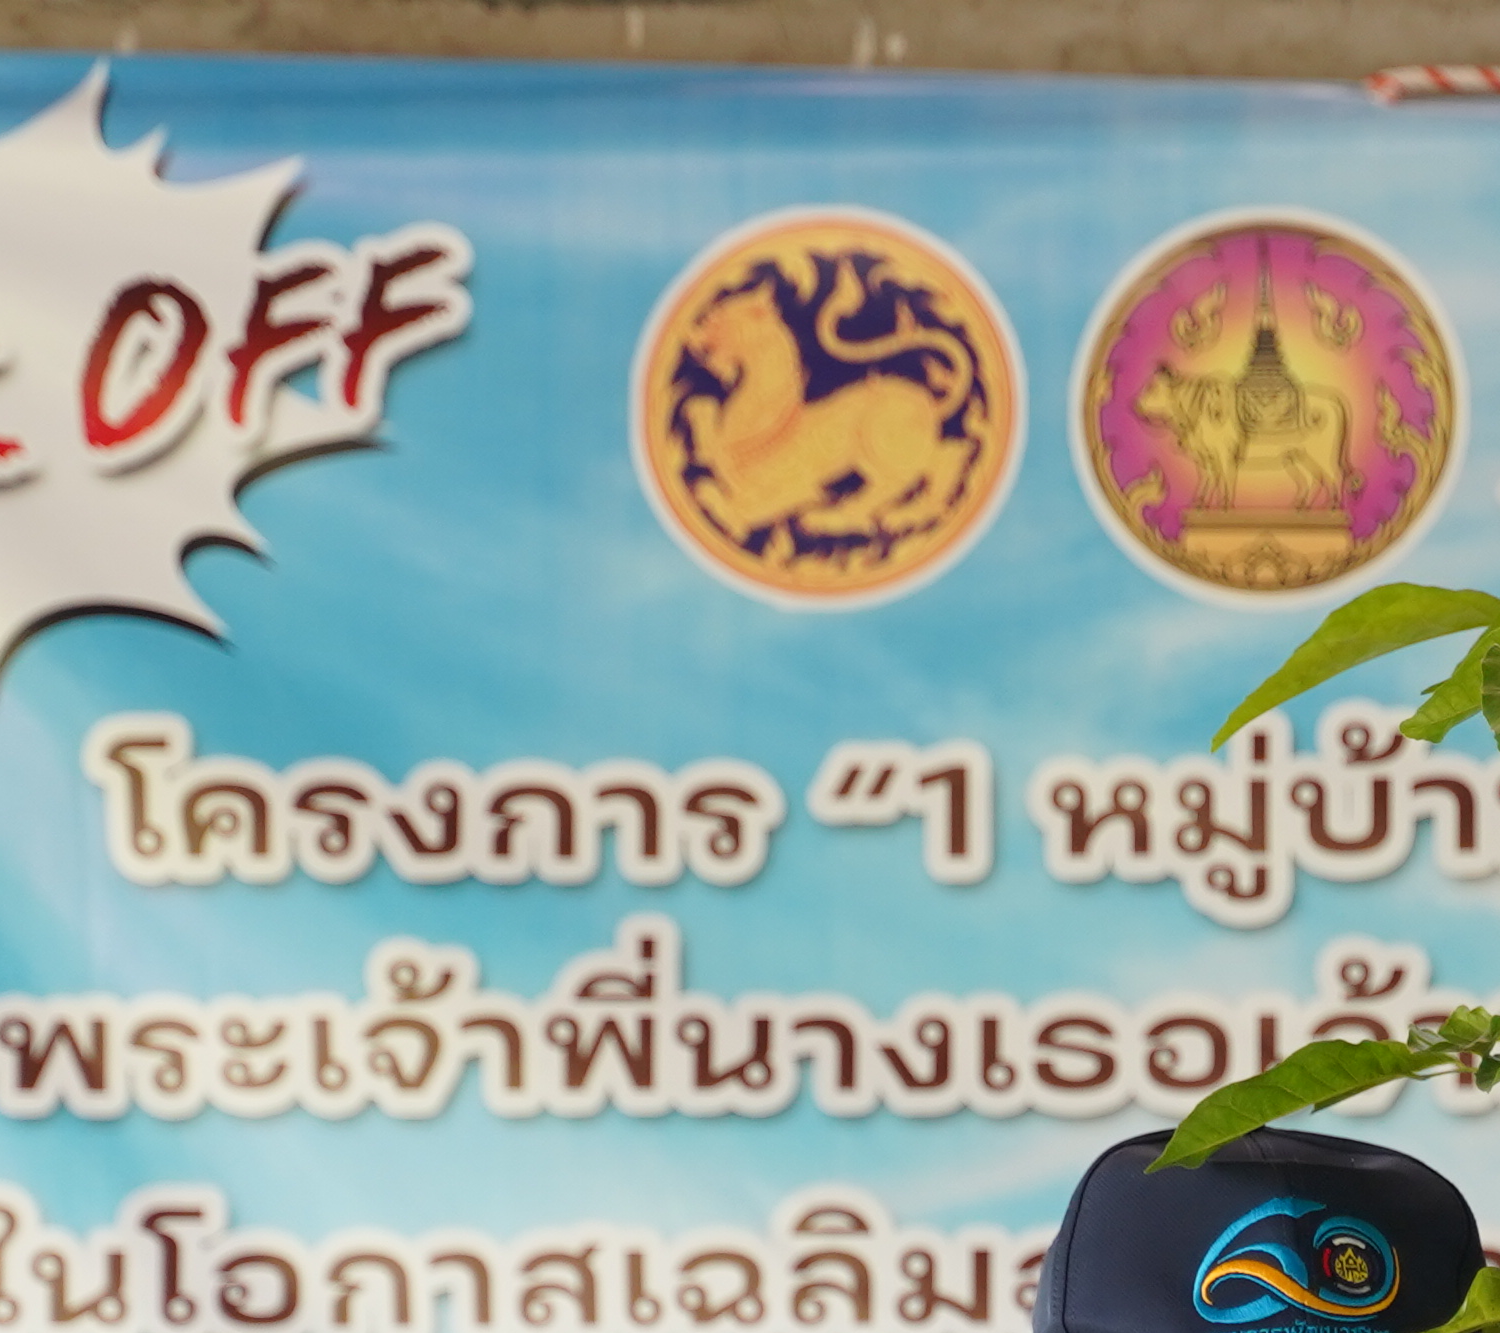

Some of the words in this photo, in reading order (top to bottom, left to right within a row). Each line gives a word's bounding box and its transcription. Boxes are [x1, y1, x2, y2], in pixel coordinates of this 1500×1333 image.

[80, 240, 455, 450] OFF
[107, 736, 767, 861] โครงการ
